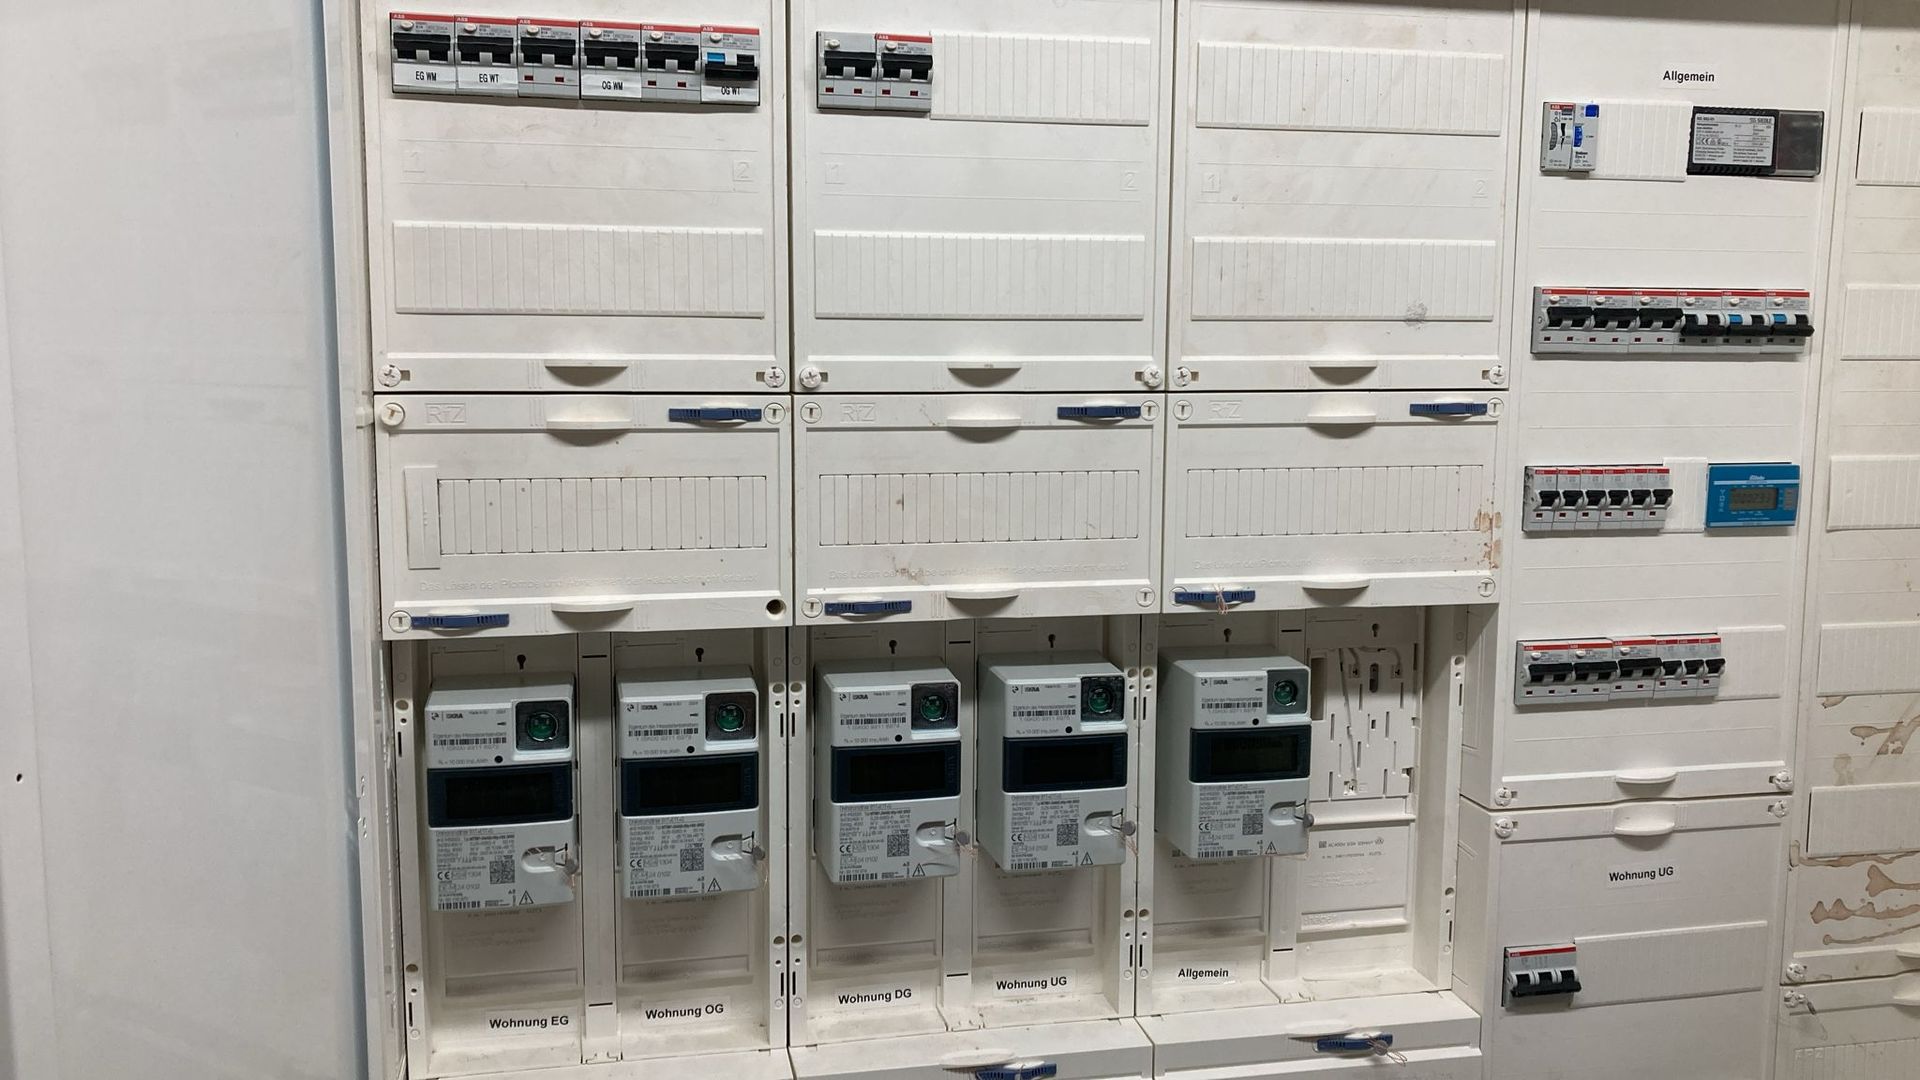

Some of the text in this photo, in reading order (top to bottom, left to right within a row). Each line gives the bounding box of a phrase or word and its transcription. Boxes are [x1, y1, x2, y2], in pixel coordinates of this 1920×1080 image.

[415, 71, 437, 81] EG WM
[479, 73, 499, 84] EG WT
[1663, 70, 1715, 84] Allgemein
[602, 80, 623, 90] OG WM
[721, 86, 731, 95] OG
[1609, 866, 1674, 882] Wohnung UG
[1178, 967, 1229, 979] Allgemein
[996, 976, 1067, 991] Wohnung UG
[838, 988, 912, 1005] Wohnung DG
[645, 1003, 724, 1020] Wohnung OG
[489, 1015, 569, 1029] Wohnung EG
